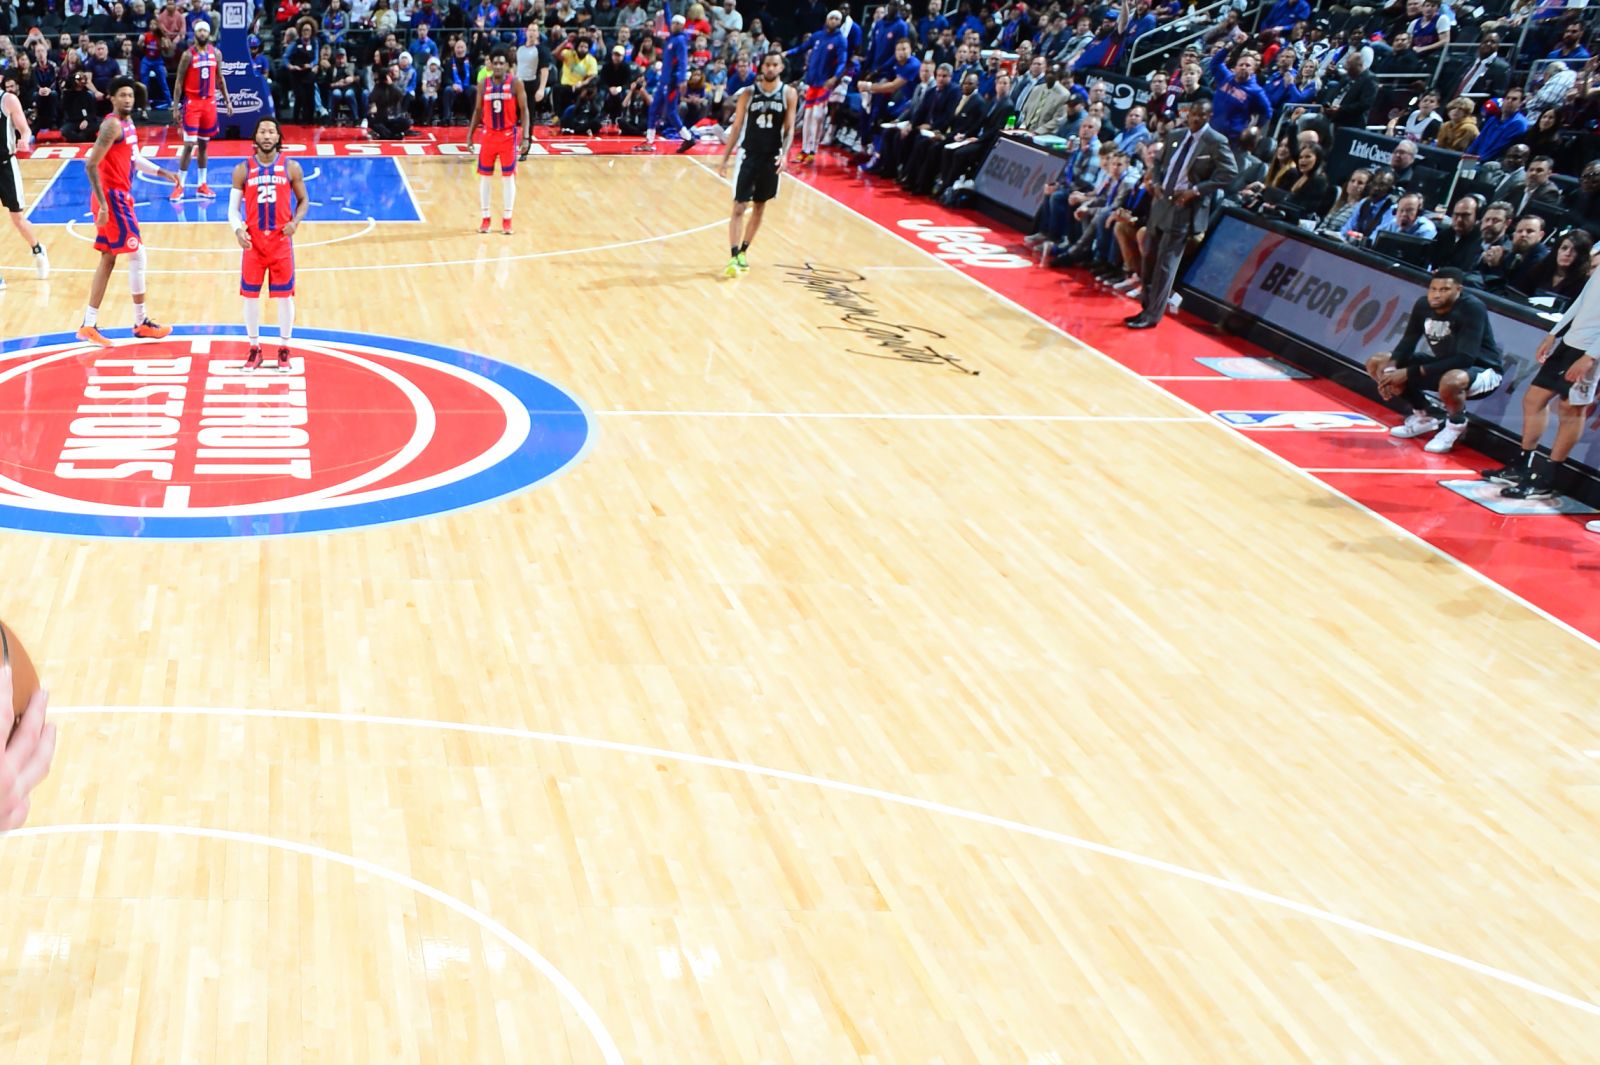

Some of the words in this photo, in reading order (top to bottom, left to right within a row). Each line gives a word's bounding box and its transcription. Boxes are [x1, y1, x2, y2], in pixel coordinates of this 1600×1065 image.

[201, 67, 209, 79] 8
[493, 100, 501, 113] 9
[756, 113, 773, 129] 41
[257, 185, 277, 203] 25
[897, 219, 1034, 269] Jeep
[1260, 262, 1348, 320] BELFOR
[54, 356, 192, 480] PISTONS
[194, 357, 312, 480] DETROIT
